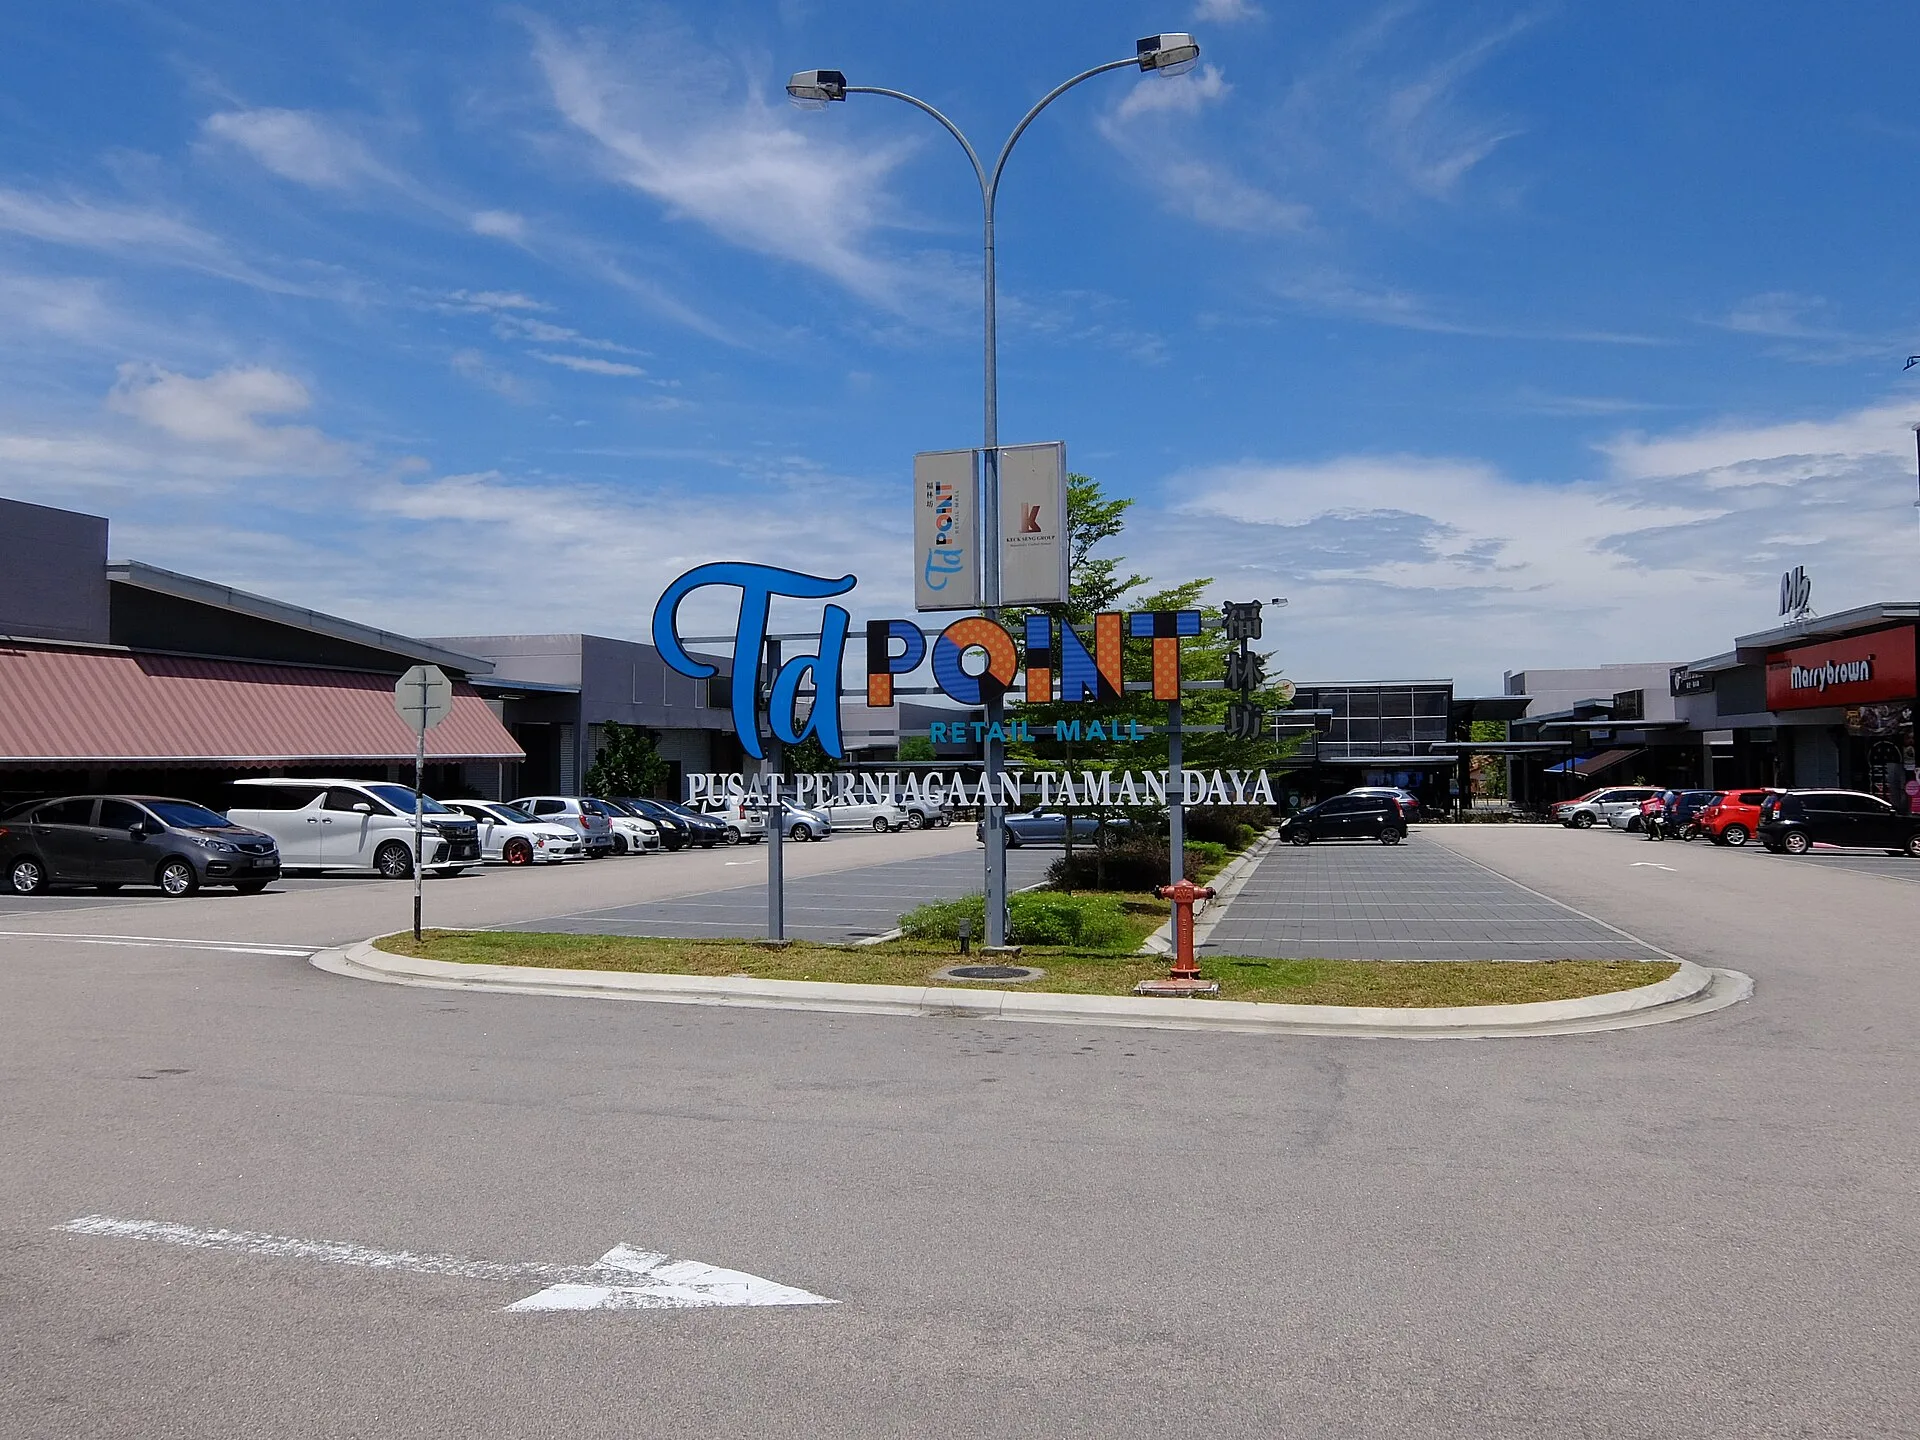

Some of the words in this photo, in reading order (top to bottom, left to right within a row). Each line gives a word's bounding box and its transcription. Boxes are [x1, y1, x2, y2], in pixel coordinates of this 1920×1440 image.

[936, 481, 953, 545] POINT
[1020, 502, 1042, 533] K
[925, 548, 963, 591] Td
[652, 561, 857, 760] Td
[867, 609, 1201, 707] POINT
[930, 720, 1035, 743] RETAIL
[1056, 719, 1145, 741] MALL
[686, 772, 785, 807] PUSAT
[793, 771, 1023, 806] PERNIAGAAN
[1033, 770, 1167, 806] TAMAN
[1180, 769, 1277, 806] DAYA
[1175, 888, 1192, 899] AVA
